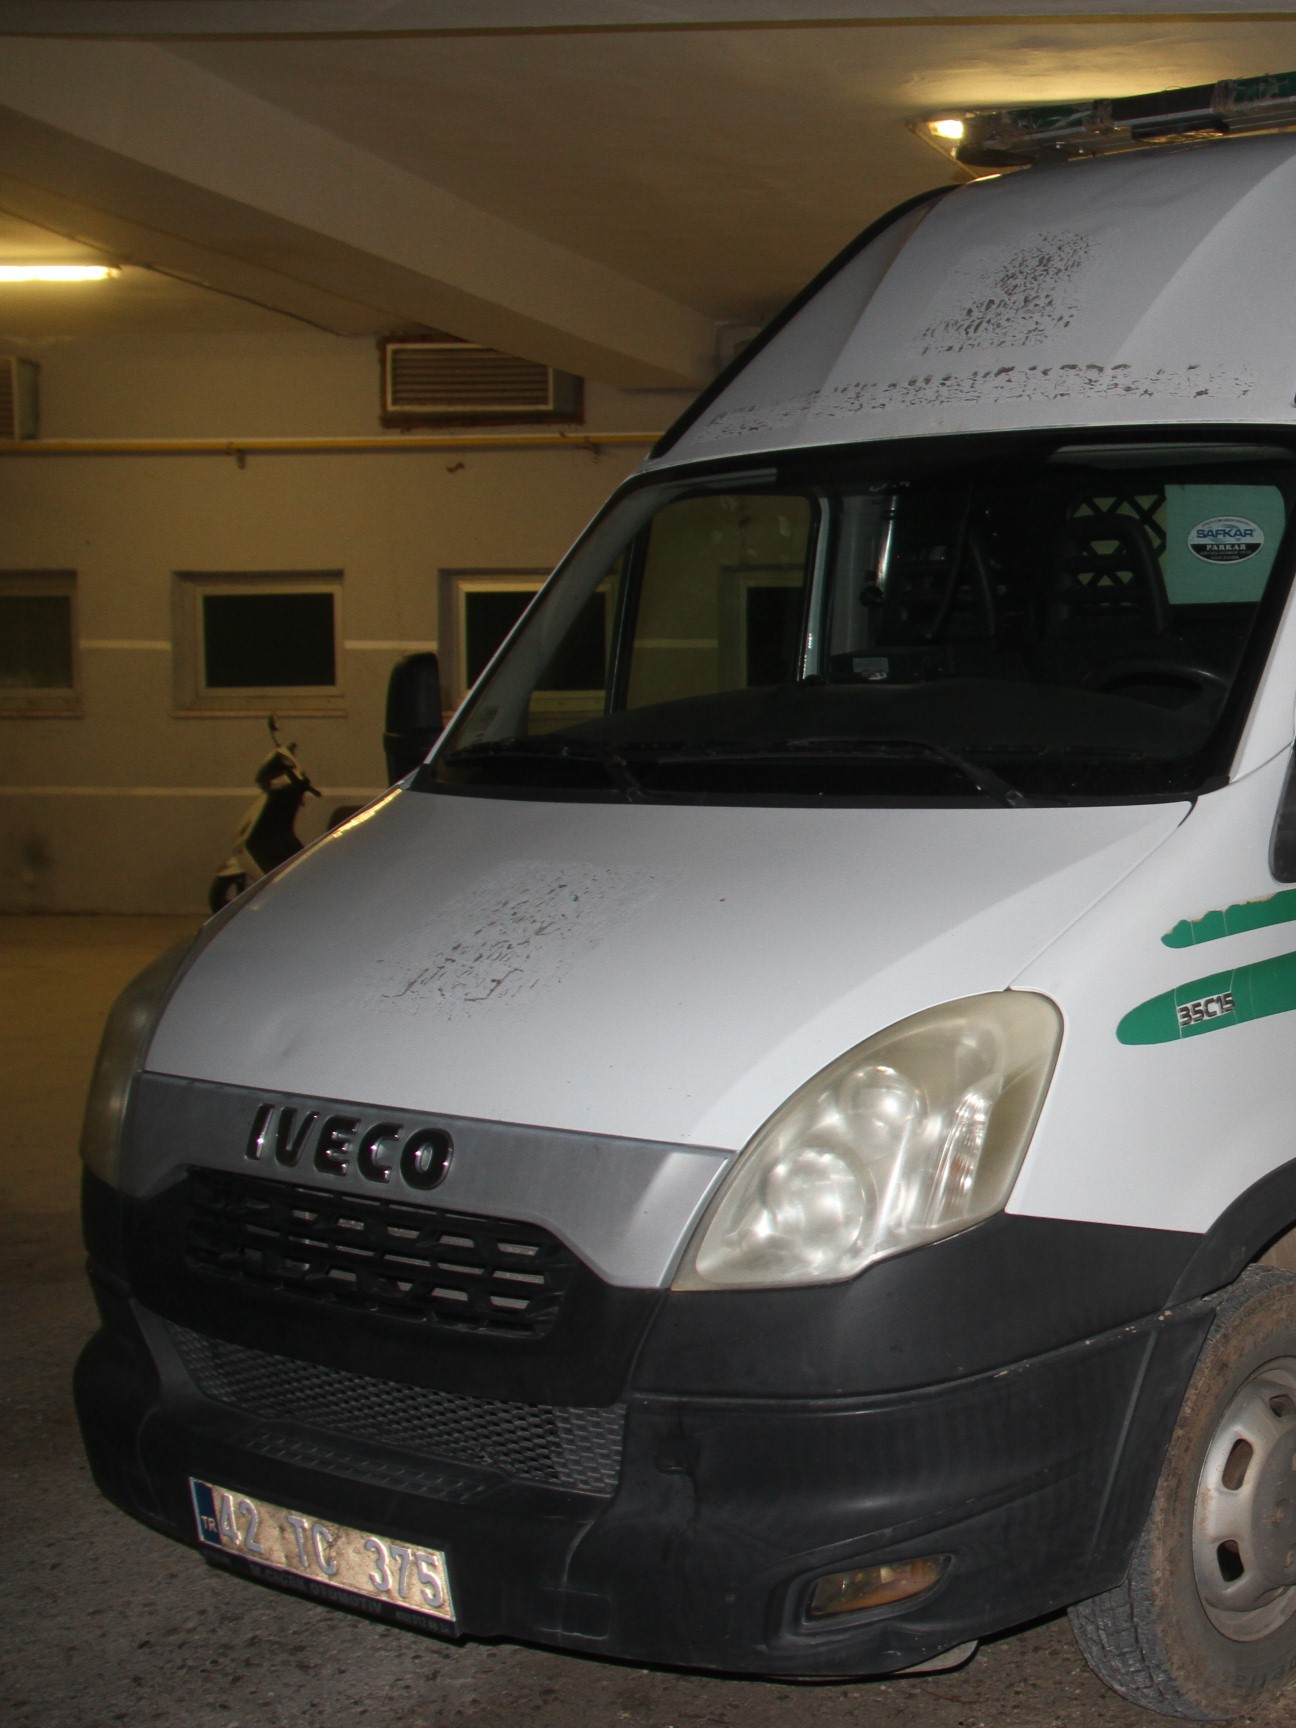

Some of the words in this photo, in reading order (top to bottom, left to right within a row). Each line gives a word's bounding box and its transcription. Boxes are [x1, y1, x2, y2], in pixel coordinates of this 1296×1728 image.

[1196, 529, 1253, 538] SAFKAR
[1178, 992, 1235, 1025] 35C15
[245, 1103, 454, 1191] IVECO
[201, 1515, 218, 1533] TR
[219, 1493, 263, 1554] 42
[287, 1515, 337, 1576] TC
[365, 1537, 443, 1608] 375
